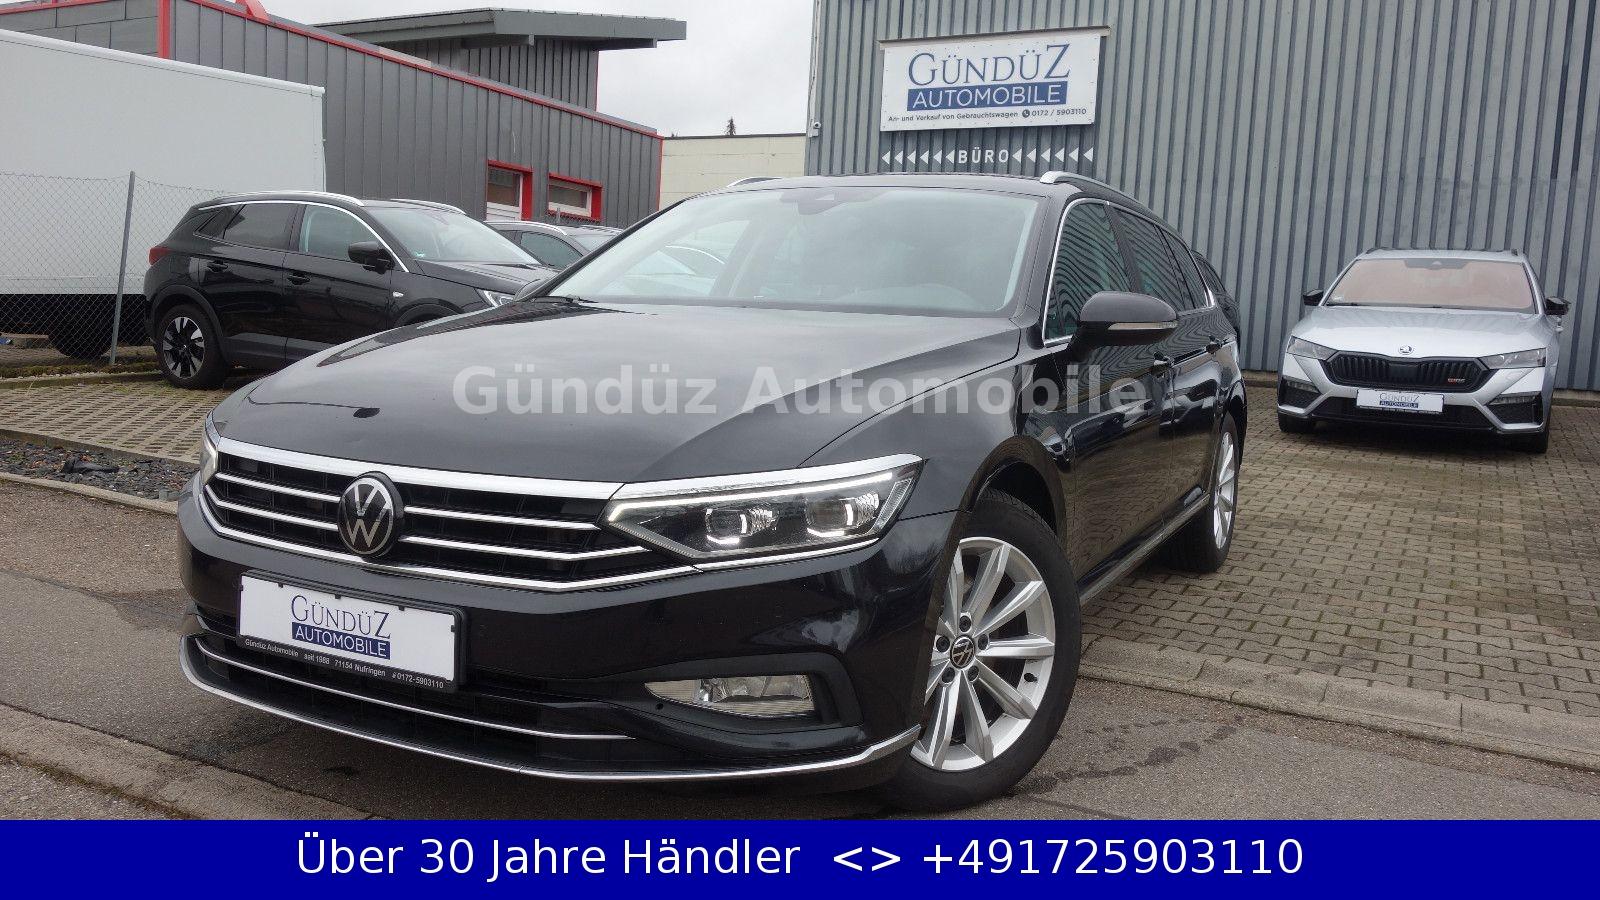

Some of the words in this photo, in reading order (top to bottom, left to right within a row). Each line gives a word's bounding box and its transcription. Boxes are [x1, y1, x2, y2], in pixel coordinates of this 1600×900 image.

[908, 43, 1071, 86] GÜNDÜZ
[912, 84, 1062, 109] AUTOMOBILE
[901, 114, 914, 122] und
[916, 113, 941, 121] Verkauf
[956, 110, 1019, 120] Gebrauchtswagen
[1031, 109, 1049, 117] 0172
[1056, 108, 1087, 116] 5903110
[958, 147, 1009, 164] BÜRO
[291, 594, 391, 639] GÜNDÜZ
[295, 625, 387, 657] AUTOMOBILE
[267, 641, 299, 657] Automobile
[303, 652, 315, 662] seit
[316, 655, 330, 665] 1988
[334, 659, 353, 670] 71154
[354, 663, 386, 677] Nufringen
